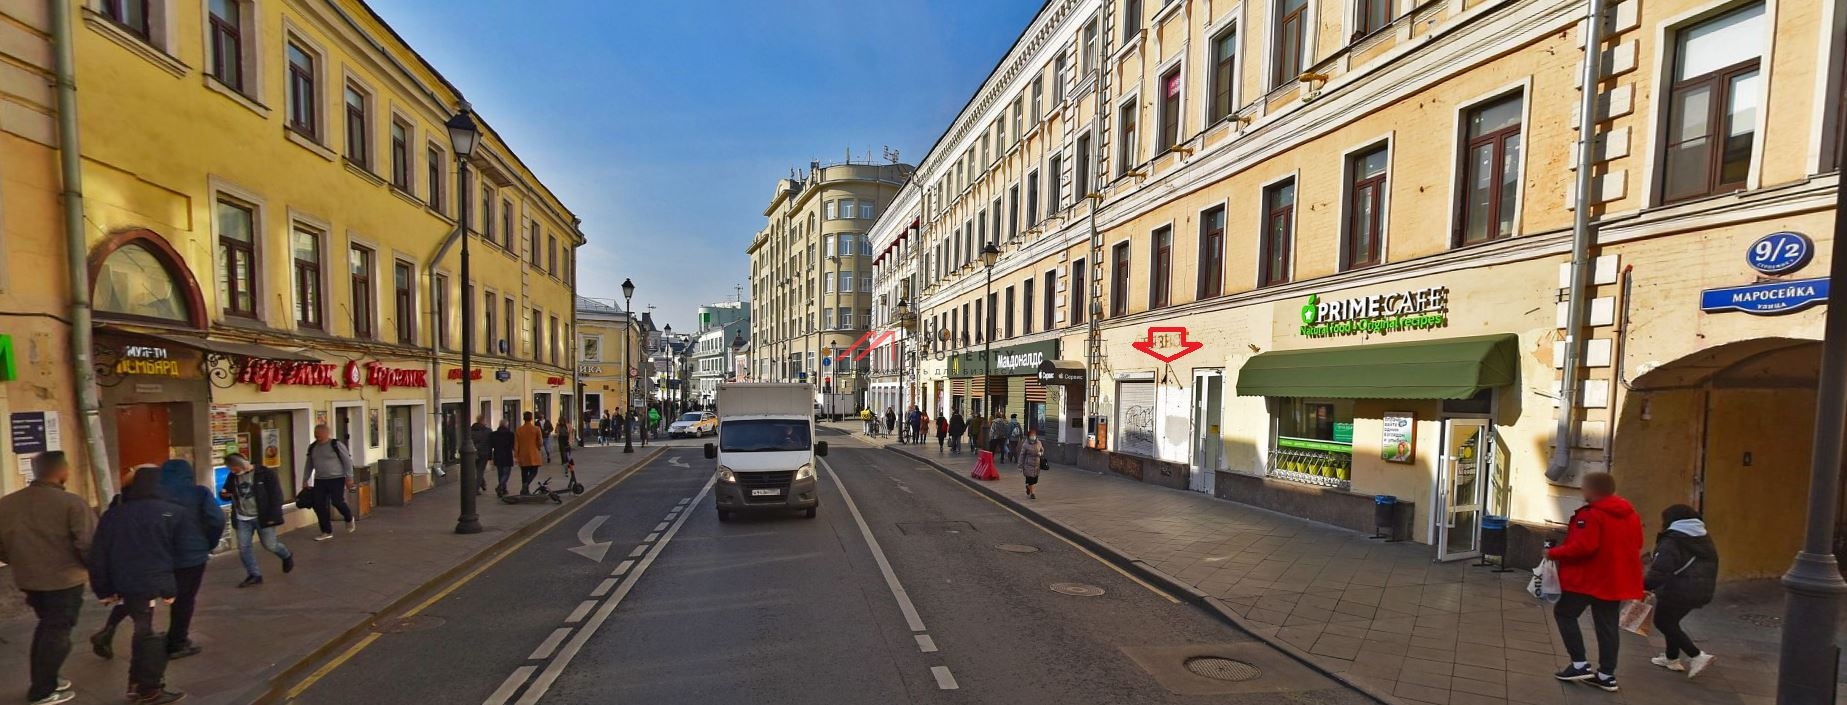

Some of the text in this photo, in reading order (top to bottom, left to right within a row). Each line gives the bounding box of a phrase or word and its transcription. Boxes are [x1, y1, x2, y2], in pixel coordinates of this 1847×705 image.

[1755, 237, 1799, 262] 9/2
[1732, 286, 1815, 303] МАРОСЕЙКА
[1317, 287, 1443, 323] PRIME CAFE
[1757, 302, 1787, 310] УЛИЦА
[1300, 313, 1443, 335] Natural food Original recipes
[996, 351, 1044, 370] Макдоналдс
